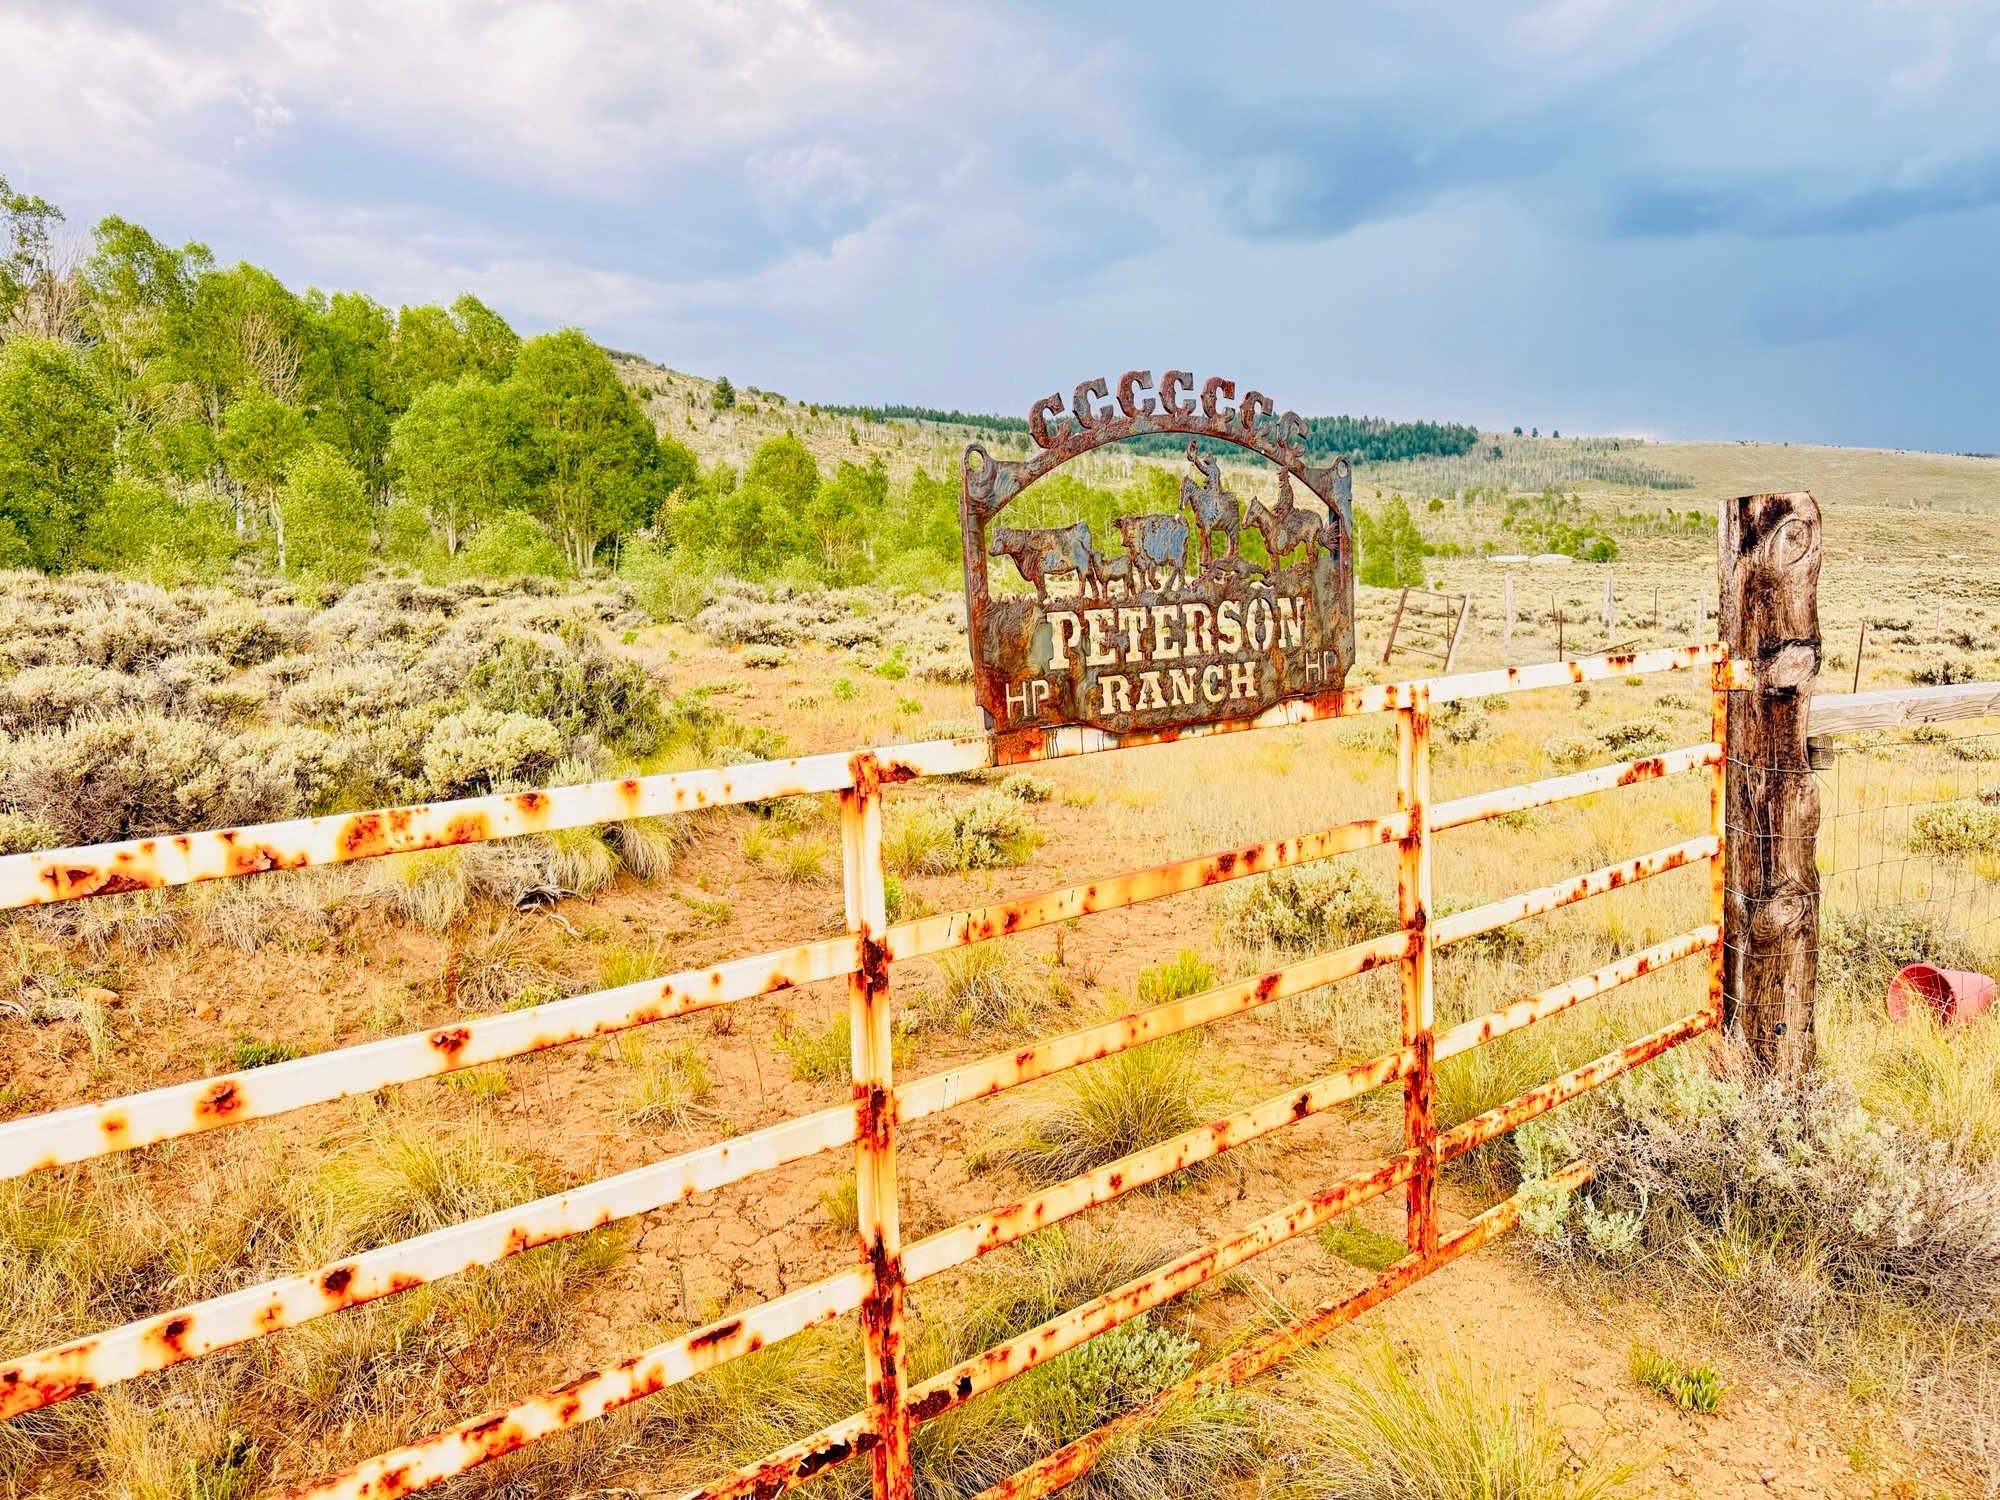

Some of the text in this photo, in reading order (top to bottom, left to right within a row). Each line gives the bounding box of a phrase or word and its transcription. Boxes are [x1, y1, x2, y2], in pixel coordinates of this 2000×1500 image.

[1046, 597, 1304, 670] PETERSON
[1098, 661, 1256, 715] RANCH
[1305, 650, 1337, 683] HP
[1005, 680, 1049, 718] HP
